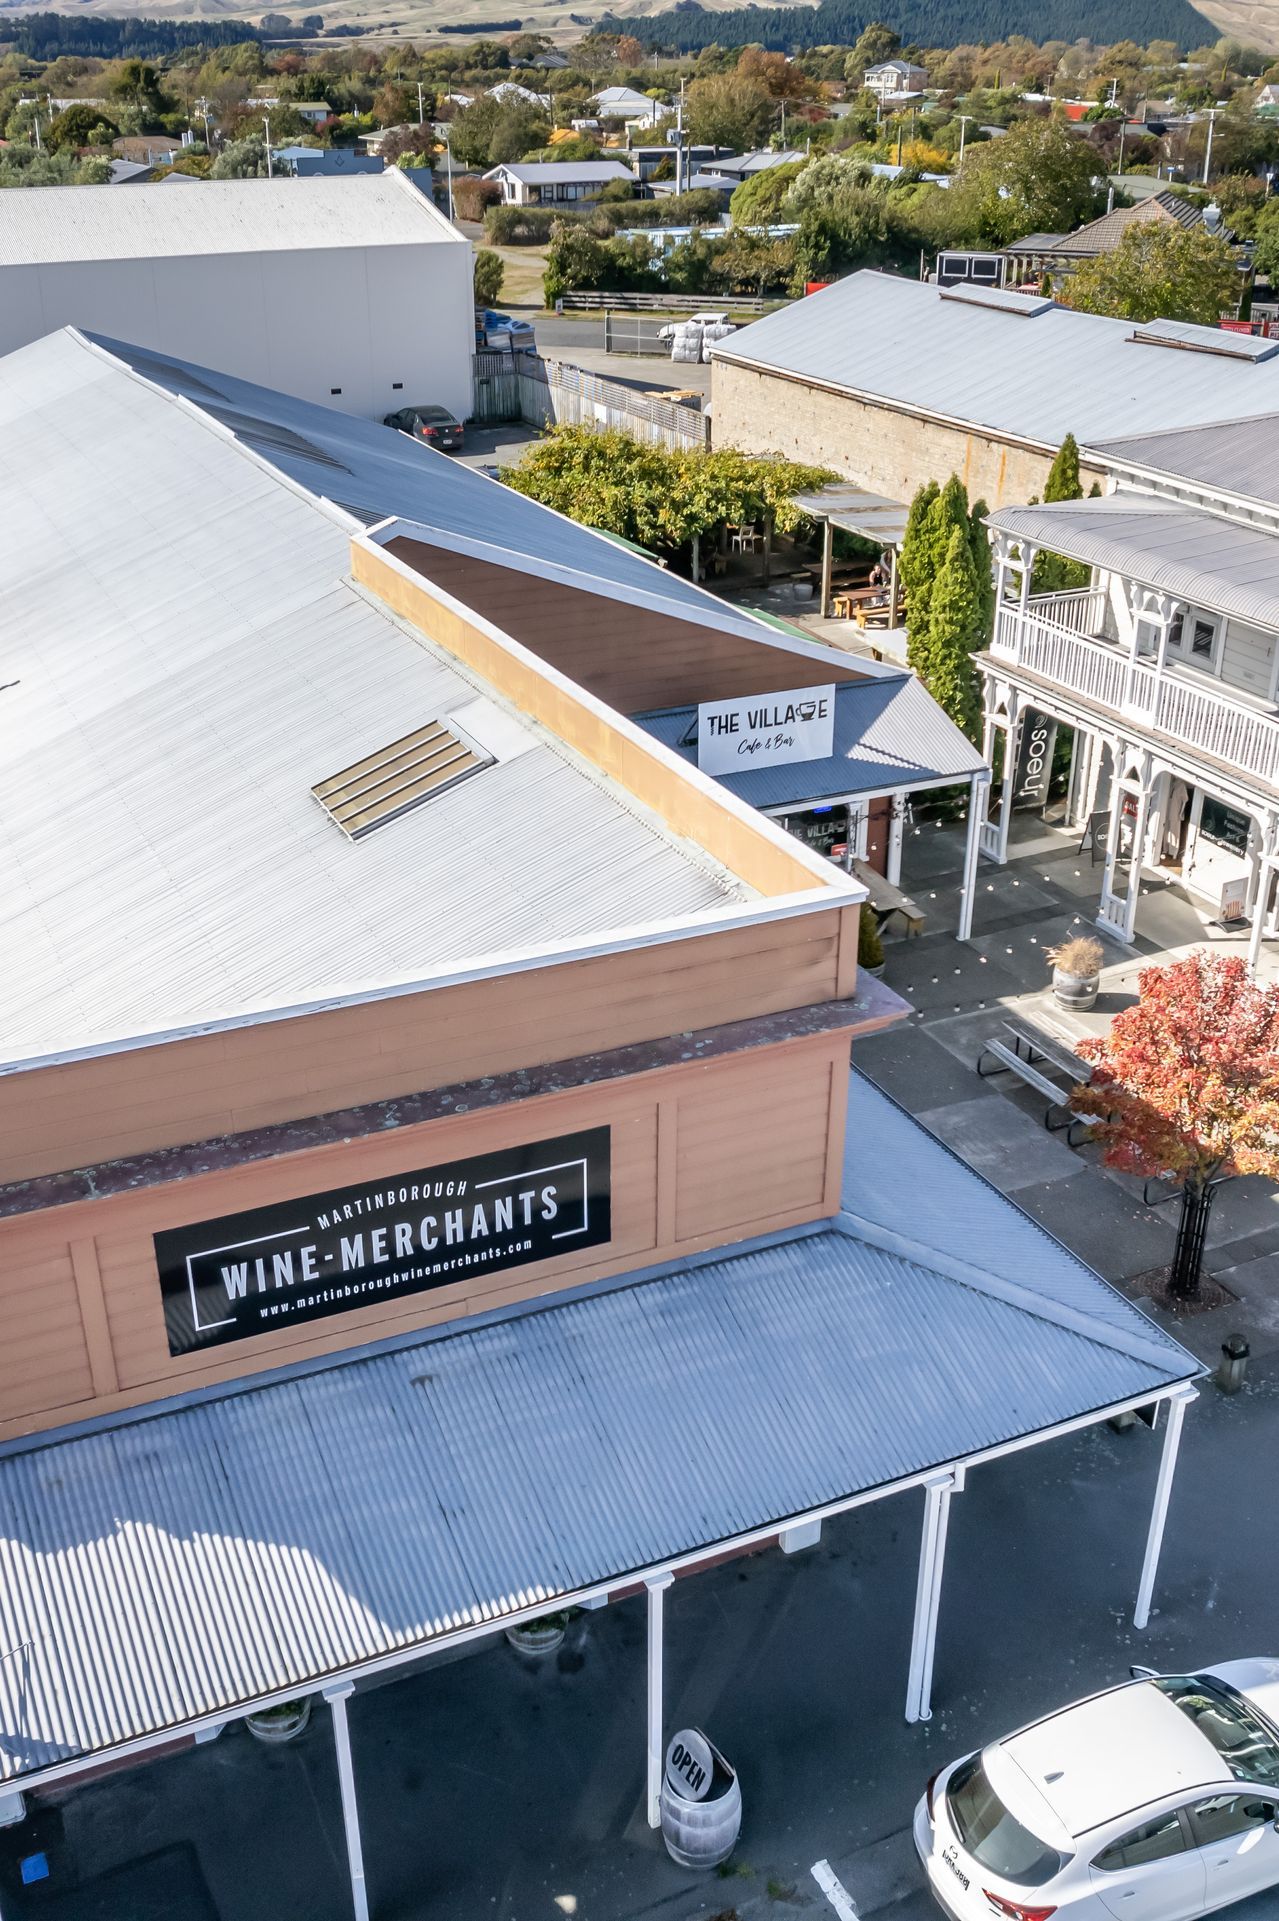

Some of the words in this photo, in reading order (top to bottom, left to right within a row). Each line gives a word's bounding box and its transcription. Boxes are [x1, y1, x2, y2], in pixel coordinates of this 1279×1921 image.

[707, 713, 739, 736] THE
[747, 699, 828, 730] VILLAGE
[737, 739, 762, 754] Cafe
[765, 738, 772, 749] &
[774, 733, 795, 750] Bar
[1020, 729, 1047, 797] soeur
[317, 1180, 468, 1230] MARTINBOROUGH
[220, 1185, 559, 1300] WINE-MERCHANTS
[259, 1239, 533, 1318] www.martinboroughwinemerchants.com
[671, 1743, 706, 1793] OPEN
